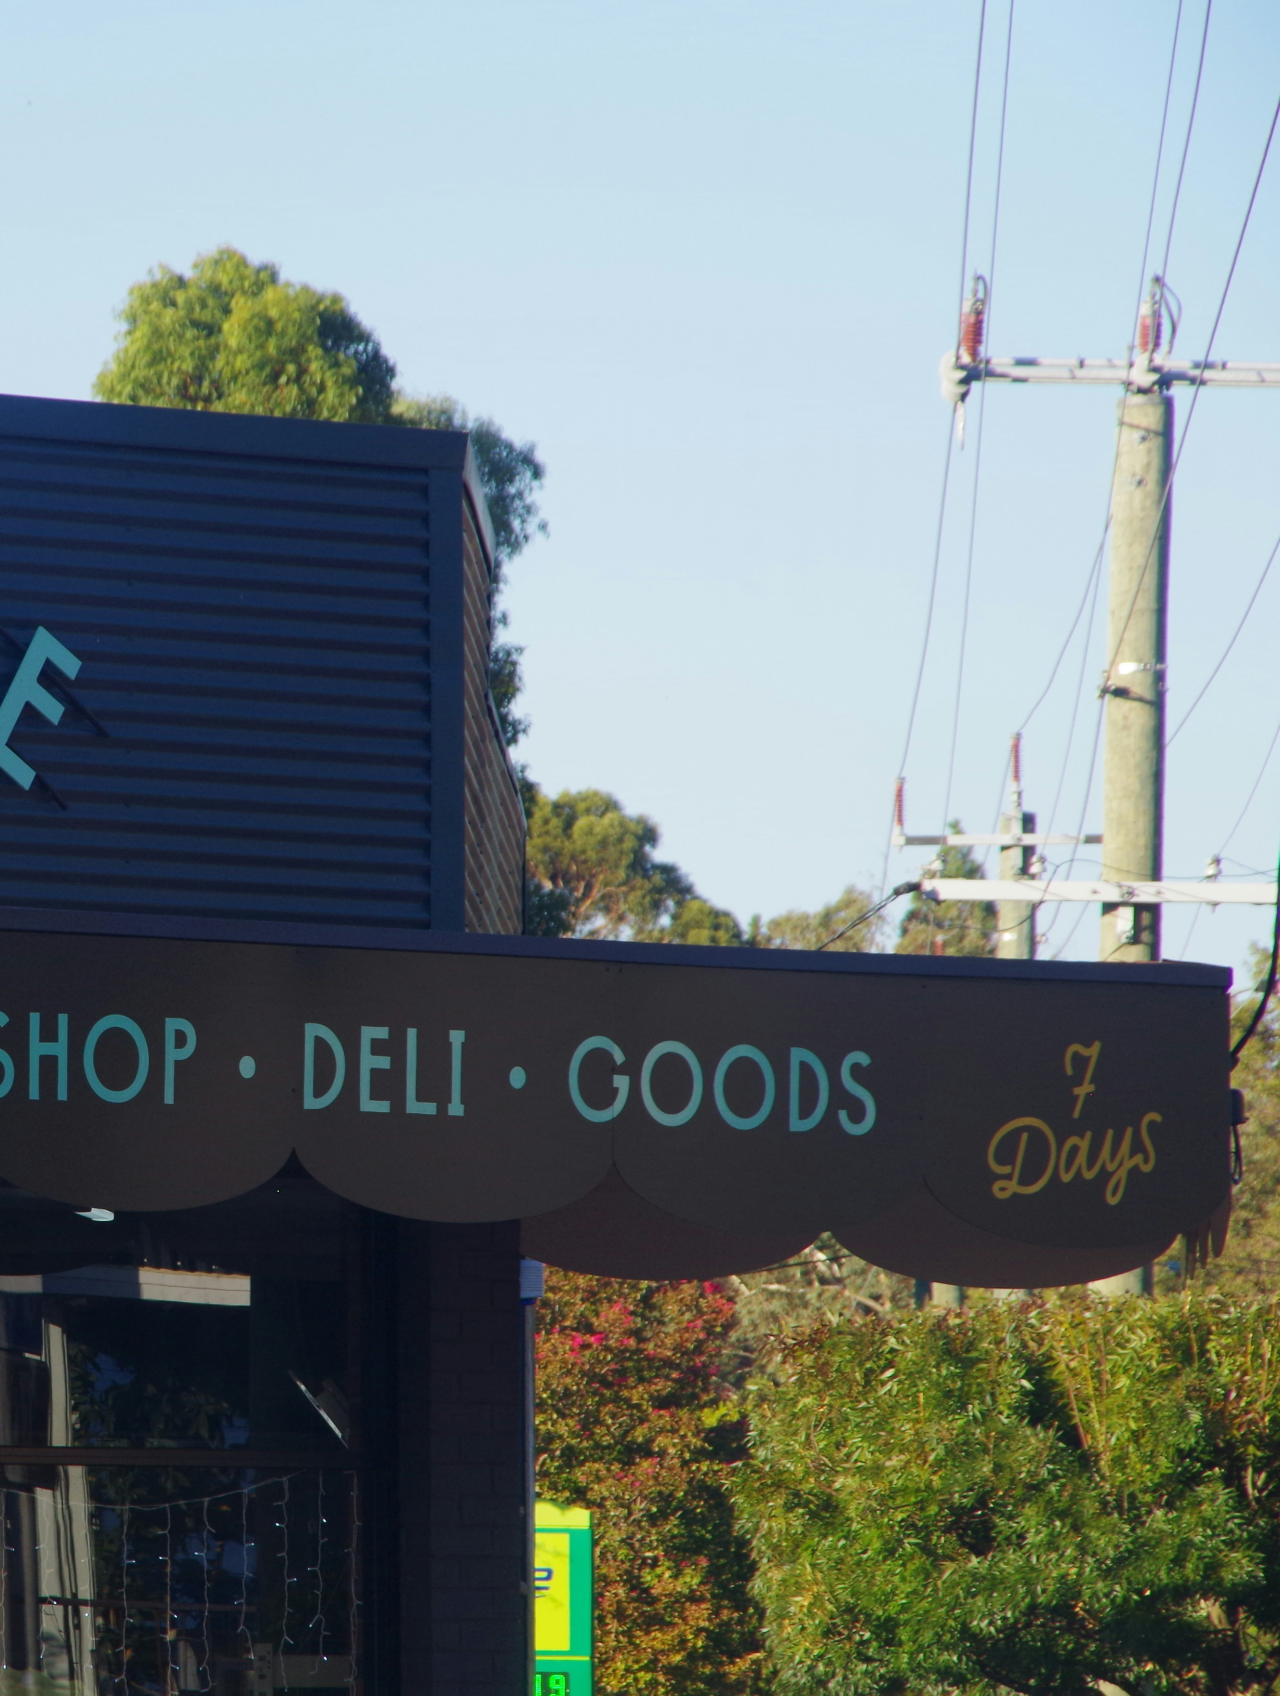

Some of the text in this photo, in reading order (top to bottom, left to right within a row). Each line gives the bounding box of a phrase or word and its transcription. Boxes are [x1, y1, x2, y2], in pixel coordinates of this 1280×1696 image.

[303, 1022, 466, 1117] DELI
[568, 1035, 877, 1136] GOODS
[1064, 1040, 1101, 1119] 7
[987, 1112, 1163, 1205] Days
